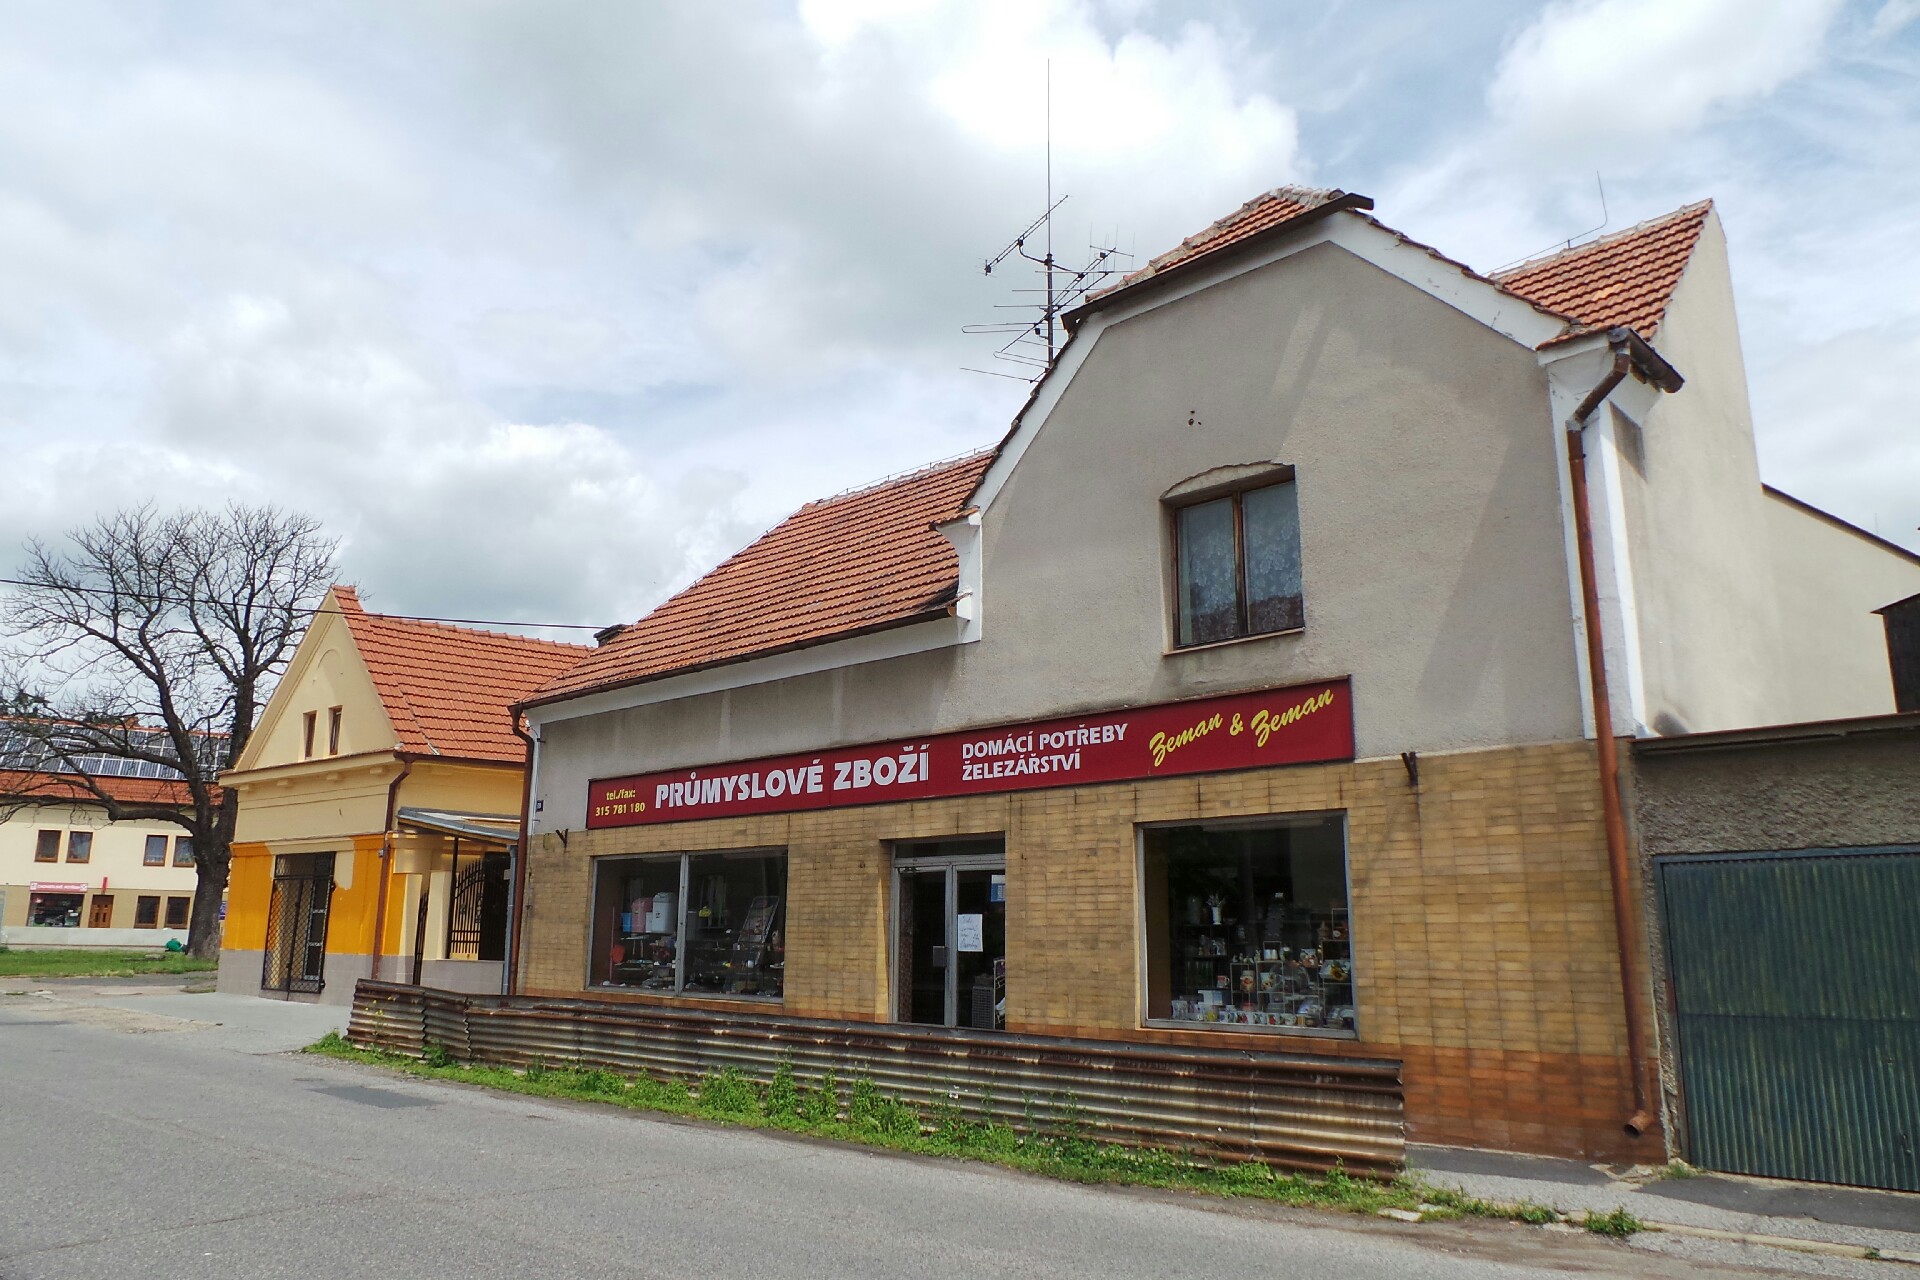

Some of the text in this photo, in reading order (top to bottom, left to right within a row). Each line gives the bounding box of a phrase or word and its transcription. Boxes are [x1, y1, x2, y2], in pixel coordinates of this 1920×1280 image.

[962, 723, 1128, 759] DOMÁCÍ POTŘEBY
[1149, 689, 1334, 768] Zeman & Zeman
[655, 743, 931, 809] PRŮMYSLOVÉ ZBOŽÍ
[962, 748, 1081, 781] ŽELEZÁŘSTVÍ
[595, 802, 646, 817] 315 781 180
[606, 788, 636, 801] tel./fax:
